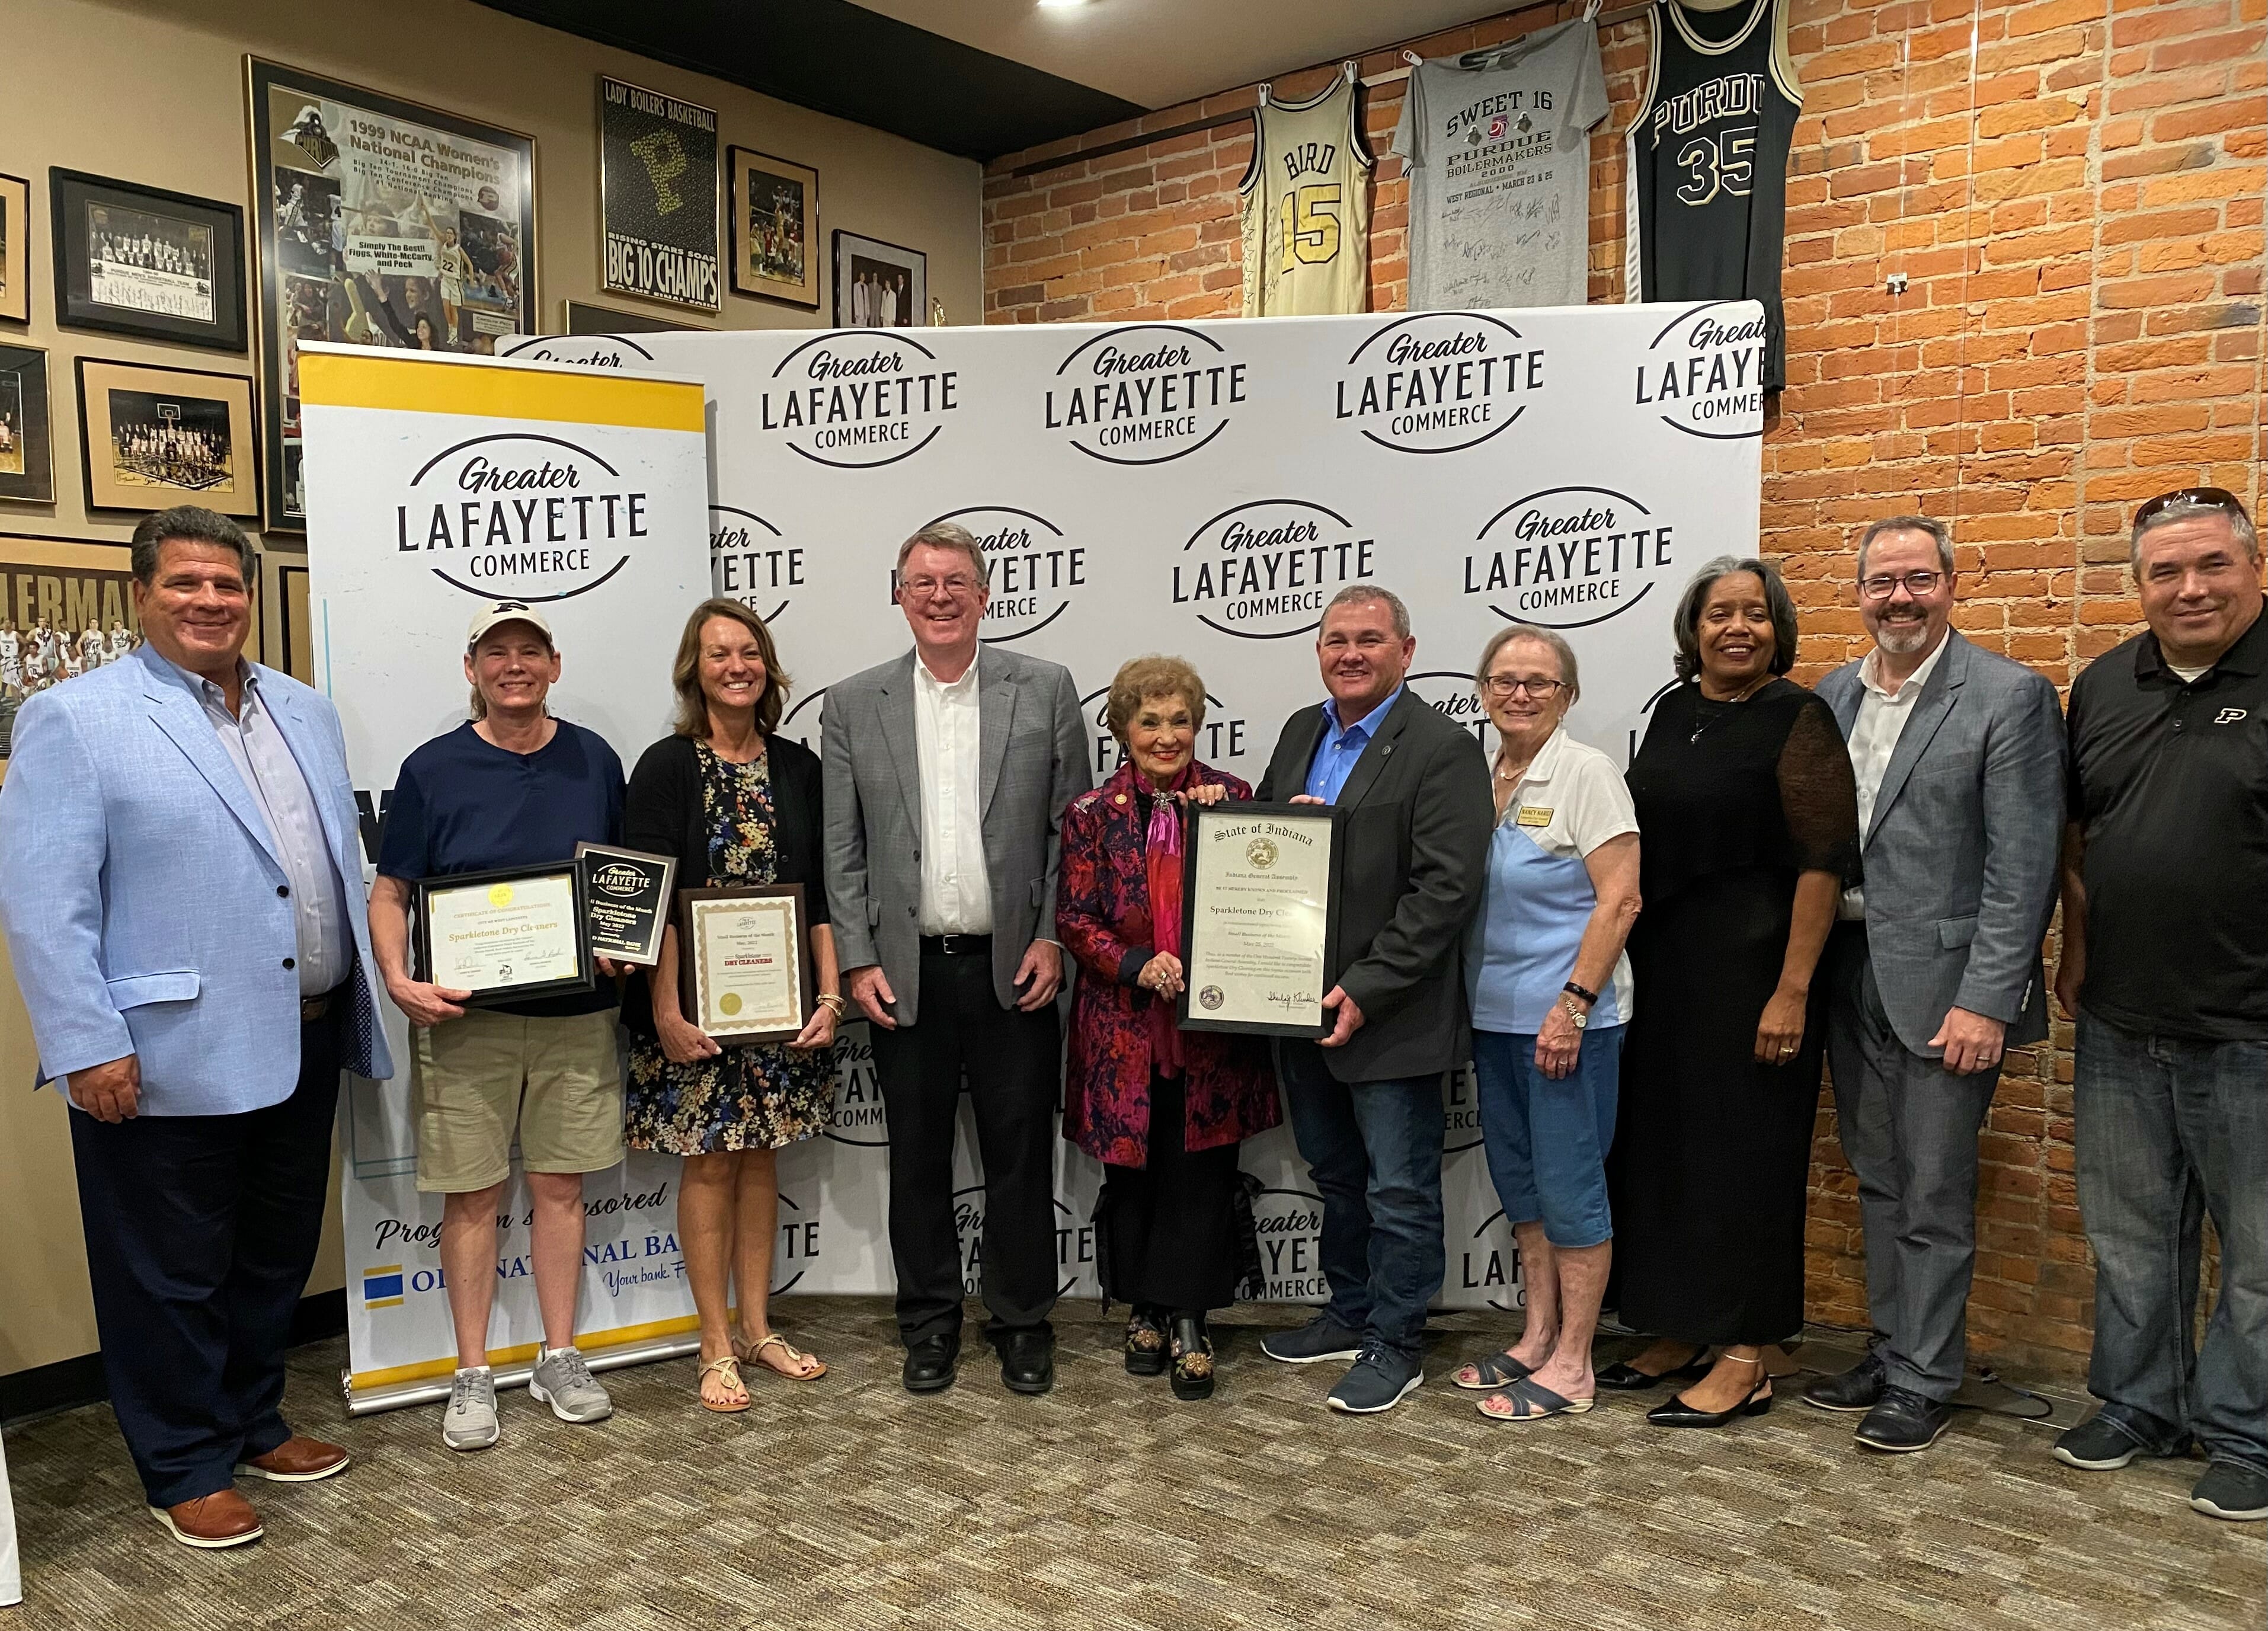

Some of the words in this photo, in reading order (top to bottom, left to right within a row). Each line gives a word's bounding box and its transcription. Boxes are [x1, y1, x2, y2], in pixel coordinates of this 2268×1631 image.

[605, 82, 627, 106] LADY
[631, 89, 664, 117] BOILERS
[668, 100, 715, 132] BASKETBALL
[1447, 91, 1522, 138] SWEET
[1533, 91, 1553, 110] 16
[1651, 73, 1765, 151] PURDU
[350, 120, 386, 139] 1999
[437, 142, 500, 170] Women's
[350, 135, 415, 163] National
[421, 153, 500, 185] Champions
[1284, 143, 1335, 180] BIRD
[1447, 130, 1551, 167] PURDUE
[1447, 143, 1552, 178] BOILERMAKERS
[1482, 164, 1514, 178] 2000
[1677, 126, 1758, 206] 35
[1447, 193, 1463, 204] WEST
[1464, 186, 1493, 200] REGIONAL
[1502, 178, 1525, 190] MARCH
[1527, 175, 1535, 184] 23
[1545, 171, 1553, 180] 25
[1281, 183, 1342, 275] 15
[348, 248, 373, 258] Figgs,
[359, 241, 386, 251] Simply
[608, 232, 647, 246] RISING
[651, 242, 684, 255] STARS
[687, 251, 716, 263] SOAR
[394, 260, 413, 268] Peck
[442, 259, 453, 273] 22
[608, 239, 634, 286] BIG
[637, 245, 652, 289] 10
[655, 251, 717, 303] CHAMPS
[1387, 331, 1488, 366] Greater
[1688, 315, 1767, 350] Great
[808, 350, 903, 381] Greater
[1093, 344, 1191, 378] Greater
[762, 372, 958, 430] LAFAYETTE
[1045, 364, 1247, 429] LAFAYETTE
[1336, 350, 1545, 420] LAFAYETTE
[815, 422, 910, 449] COMMERCE
[1099, 416, 1196, 447] COMMERCE
[1391, 402, 1492, 436] COMMERCE
[458, 456, 581, 494] Greater
[397, 493, 648, 552] LAFAYETTE
[1221, 518, 1319, 552] Greater
[1515, 506, 1617, 541] Greater
[977, 527, 1031, 552] eater
[470, 549, 590, 578] COMMERCE
[1173, 539, 1375, 603] LAFAYETTE
[1464, 526, 1673, 594] LAFAYETTE
[981, 597, 1037, 621] MERCE
[1226, 590, 1323, 621] COMMERCE
[1519, 578, 1620, 611] COMMERCE
[2214, 708, 2247, 724] P
[1214, 825, 1247, 842] State
[1251, 823, 1262, 834] of
[1265, 823, 1314, 846] Indiana
[593, 874, 651, 888] LAFAYETTE
[607, 866, 636, 877] Greater
[590, 912, 604, 920] Dry
[605, 914, 637, 925] Cleaners
[595, 899, 619, 908] Business
[1210, 906, 1257, 915] Sparkletone
[1259, 908, 1274, 917] Dry
[449, 929, 500, 942] Sparkletone
[503, 926, 519, 935] Dry
[833, 1107, 883, 1128] COMM
[1251, 1210, 1320, 1234] eater
[645, 1233, 679, 1256] BA
[603, 1269, 639, 1298] Your
[641, 1262, 671, 1284] bank.
